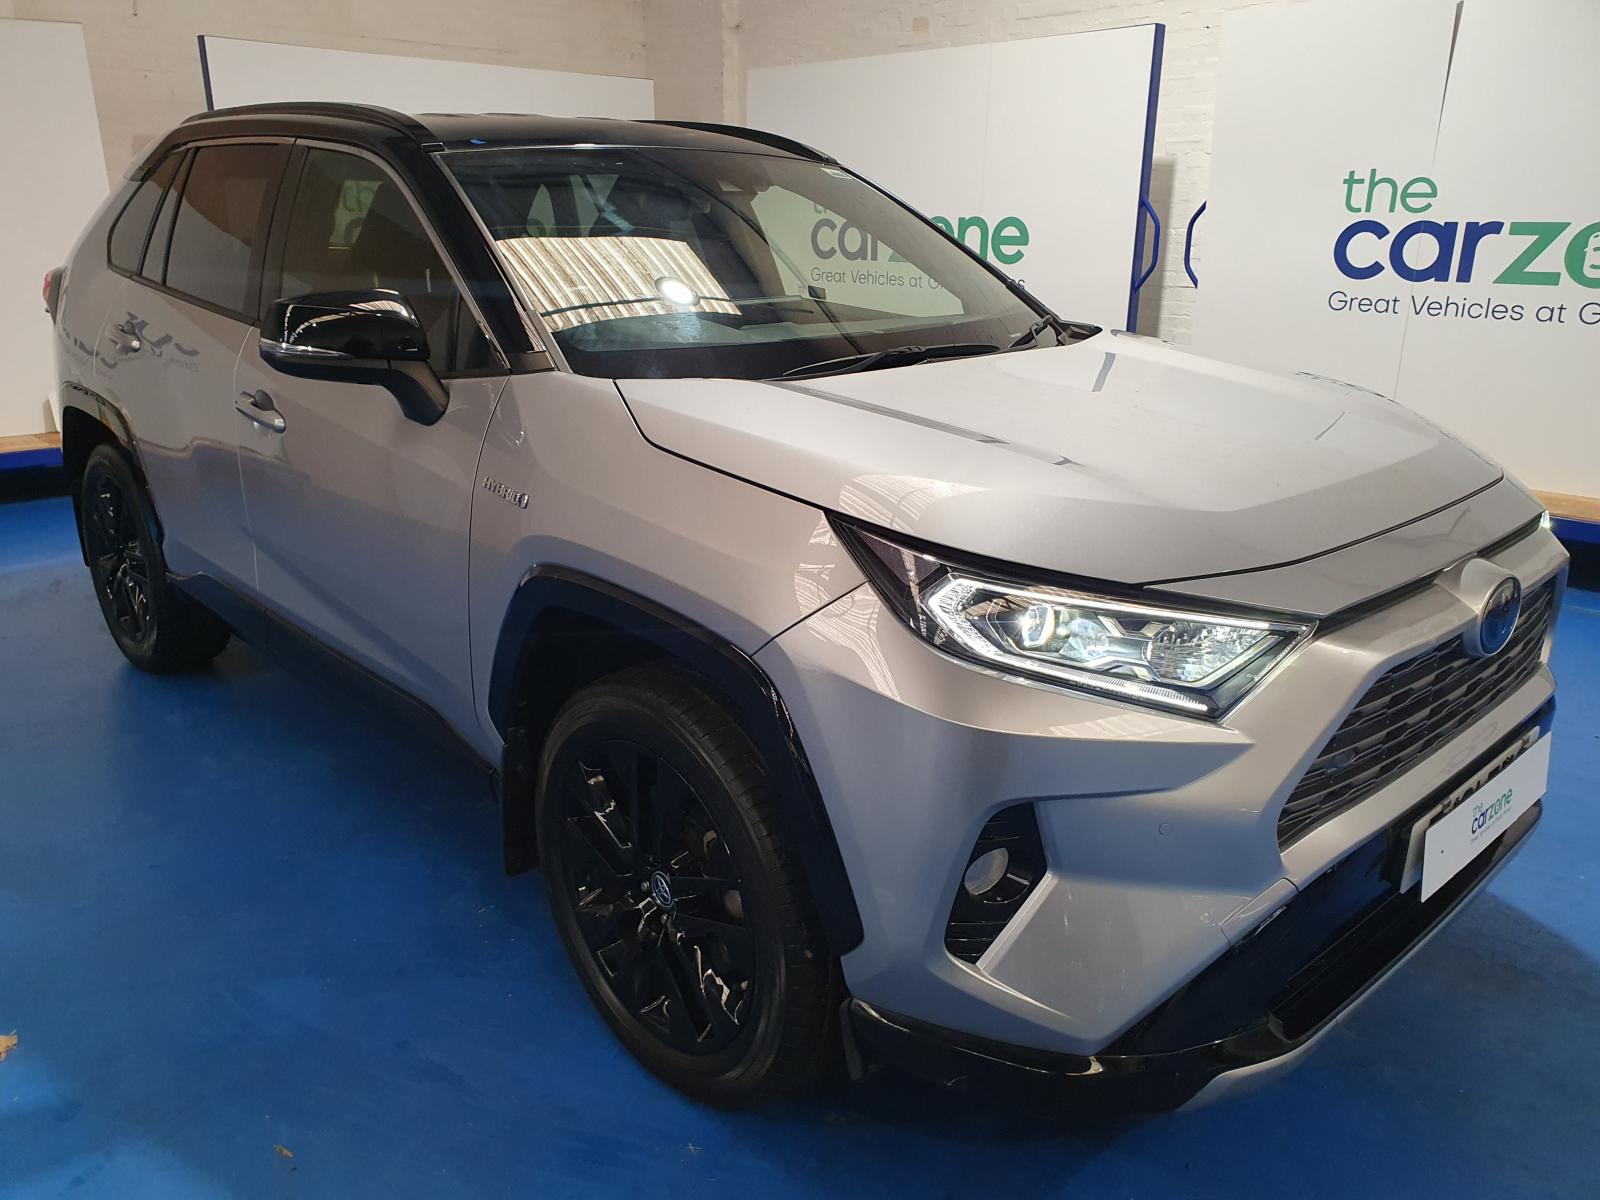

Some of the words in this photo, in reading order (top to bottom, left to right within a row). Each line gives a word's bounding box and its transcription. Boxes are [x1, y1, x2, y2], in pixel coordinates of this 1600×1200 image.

[1343, 168, 1438, 214] the
[811, 266, 846, 283] Great
[850, 270, 905, 286] Vehicles
[908, 275, 923, 288] at
[1328, 291, 1400, 315] Great
[1411, 295, 1525, 322] Vehicles
[1535, 303, 1567, 324] at
[1471, 787, 1513, 834] carzone
